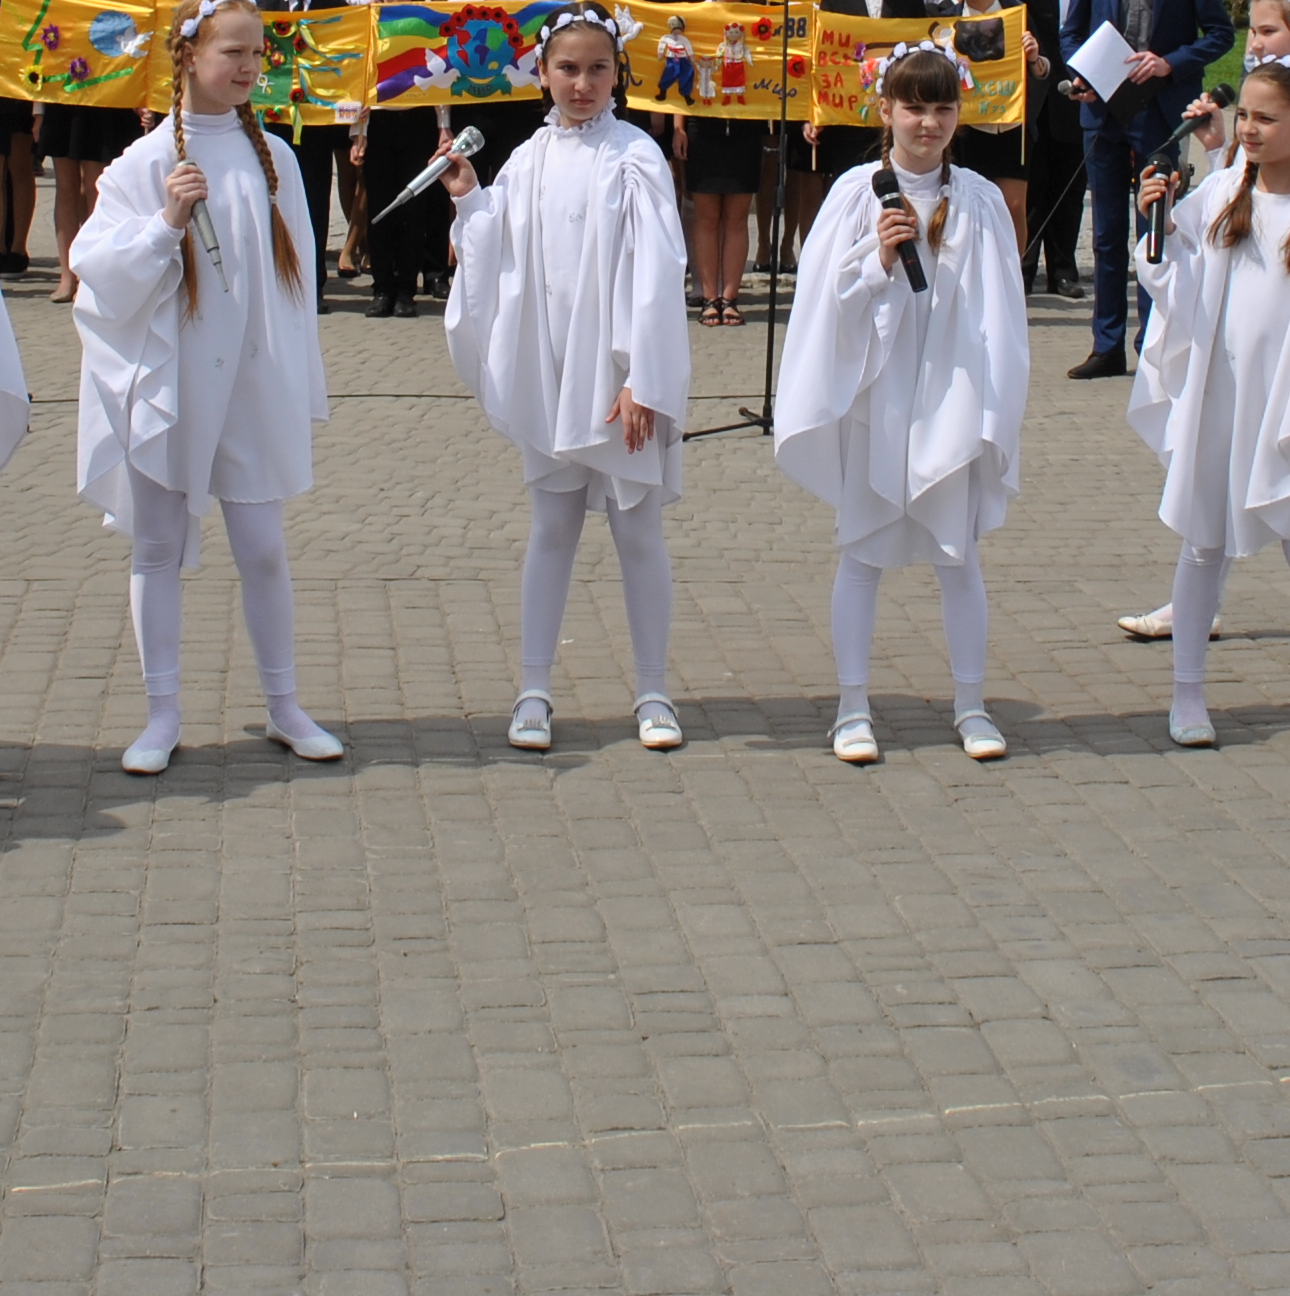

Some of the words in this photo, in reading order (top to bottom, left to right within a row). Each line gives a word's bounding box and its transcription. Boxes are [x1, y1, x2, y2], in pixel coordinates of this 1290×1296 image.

[821, 30, 851, 48] МИ
[820, 72, 845, 89] ЗА
[818, 90, 858, 112] МИР
